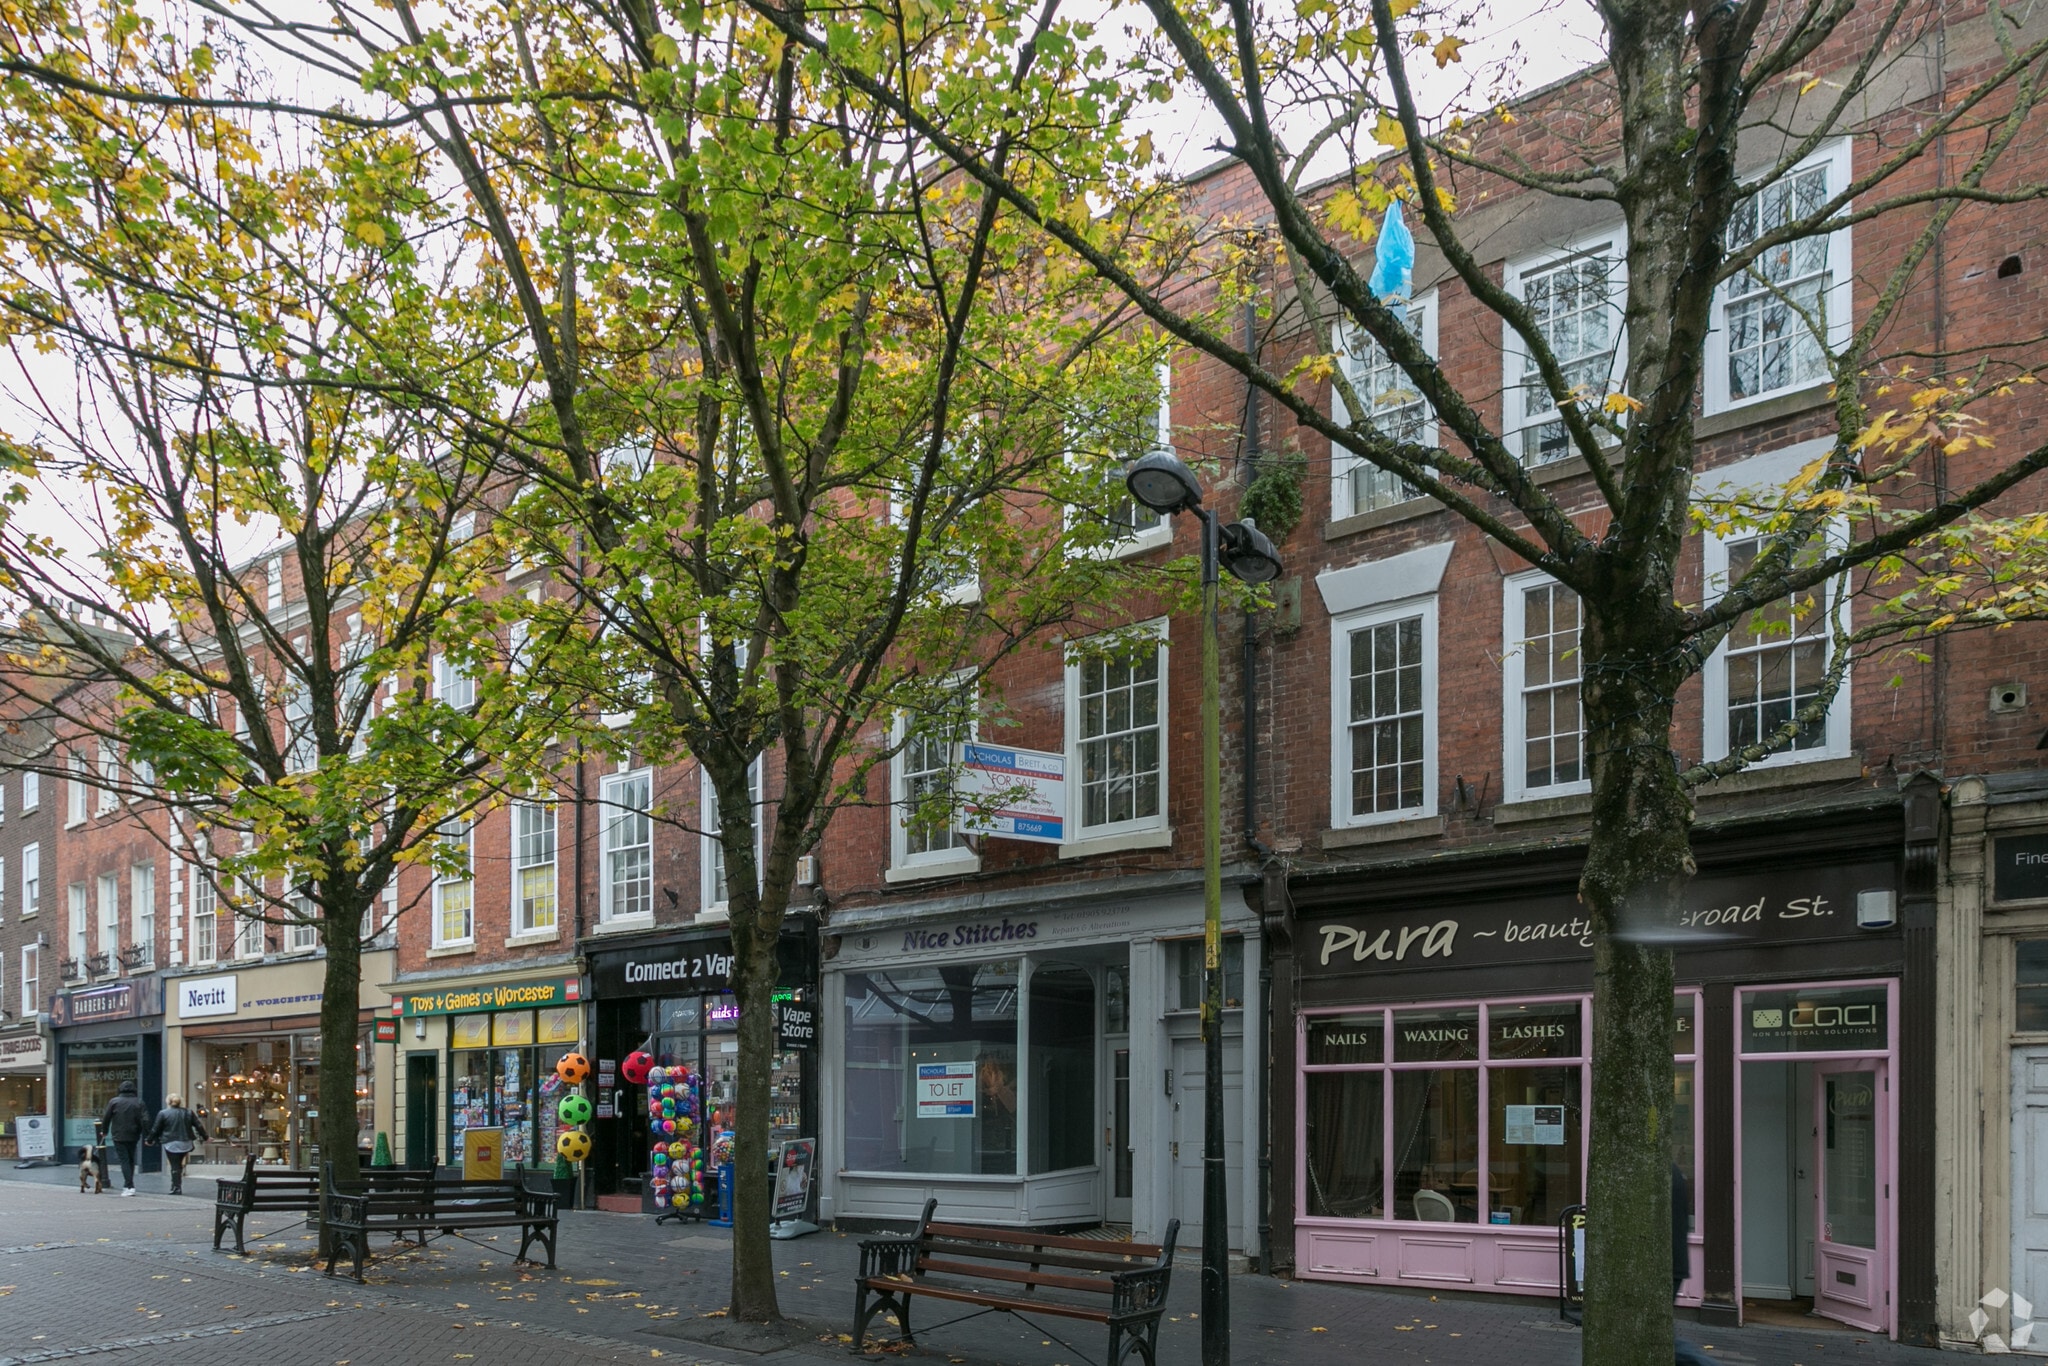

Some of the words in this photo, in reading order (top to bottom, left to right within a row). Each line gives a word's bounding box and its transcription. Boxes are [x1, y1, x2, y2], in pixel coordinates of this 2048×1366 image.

[968, 749, 1012, 764] NICHOLAS
[1018, 757, 1041, 768] BRETT
[1047, 764, 1058, 772] CO
[991, 774, 1012, 786] FOR
[1015, 776, 1038, 788] SALE
[1017, 822, 1043, 833] 875669
[1778, 895, 1835, 919] St.
[1088, 919, 1130, 931] Alterations
[902, 929, 949, 952] Nice
[953, 918, 1039, 947] Stitches
[1319, 919, 1459, 966] Pura
[624, 957, 688, 984] Connect
[691, 958, 702, 978] 2
[74, 997, 106, 1015] BARBERS
[188, 987, 225, 1008] Nevitt
[242, 1000, 252, 1008] of
[410, 996, 435, 1015] Toys
[445, 992, 481, 1011] Games
[493, 985, 556, 1007] Worcester
[782, 1006, 811, 1024] Vape
[378, 1025, 396, 1034] LEGO
[781, 1022, 813, 1038] Store
[1325, 1033, 1367, 1046] NAILS
[1404, 1028, 1469, 1042] WAXING
[1502, 1024, 1565, 1040] LASHES
[1774, 1029, 1820, 1037] SURGICAL
[1824, 1027, 1878, 1035] SOLUTIONS
[929, 1083, 945, 1097] TO
[947, 1082, 964, 1096] LET
